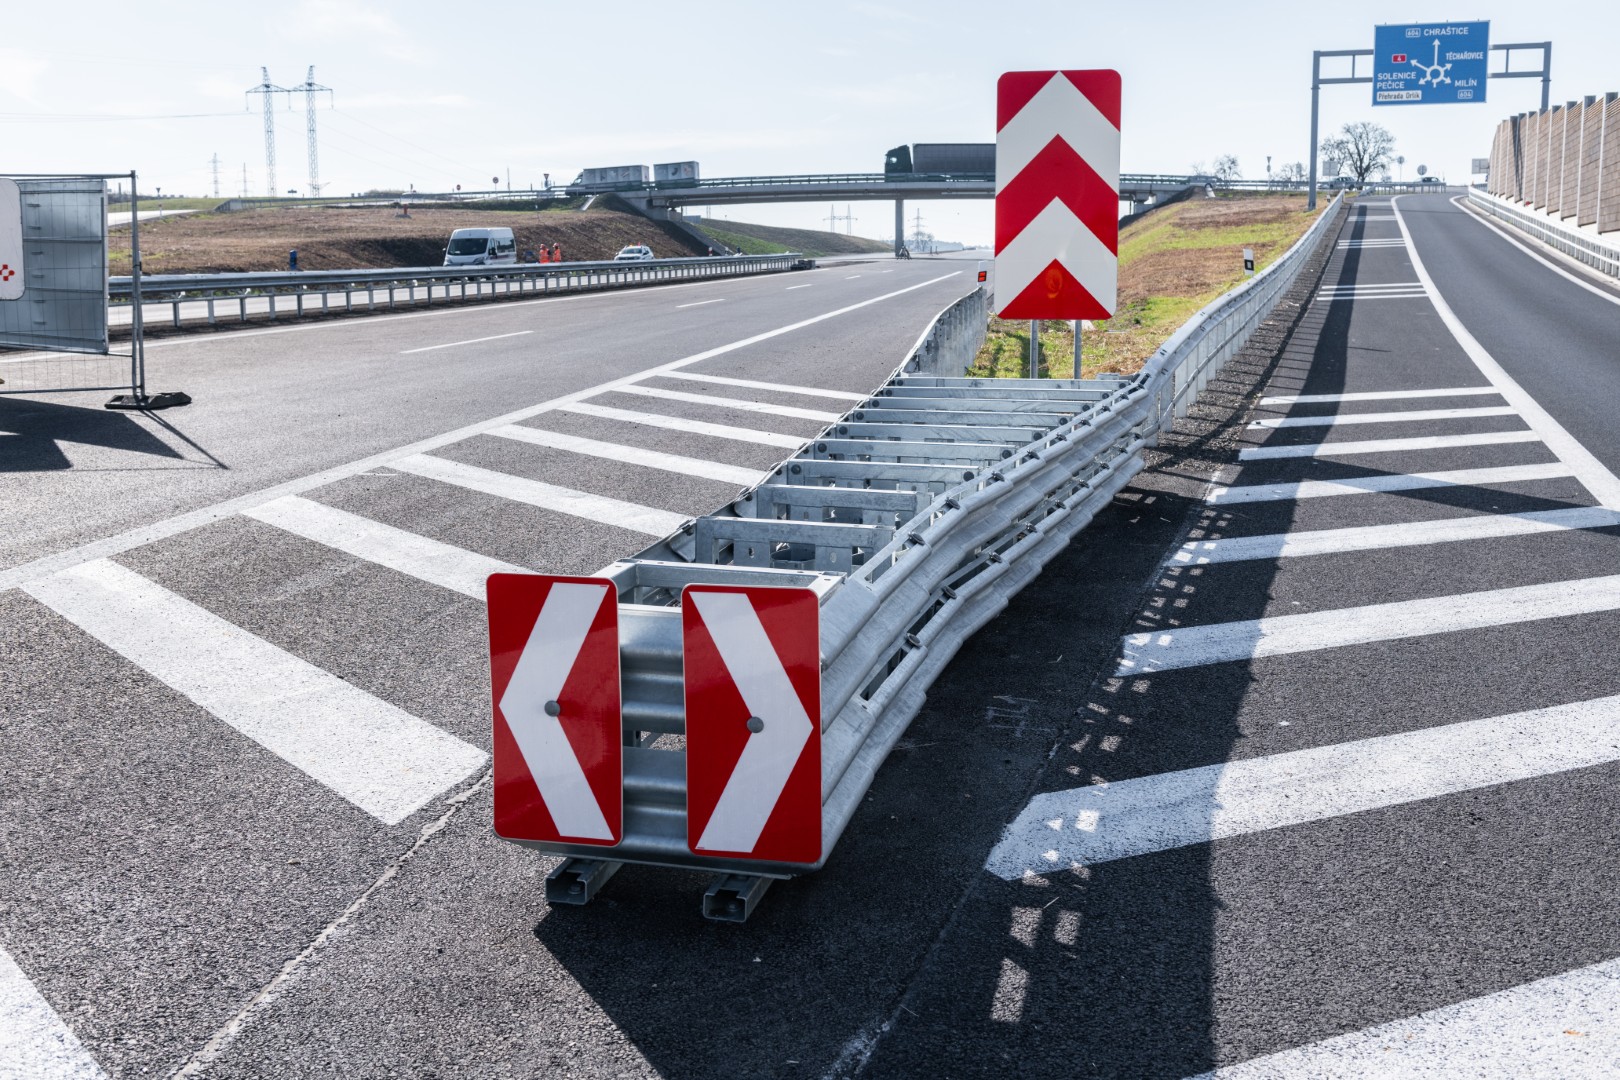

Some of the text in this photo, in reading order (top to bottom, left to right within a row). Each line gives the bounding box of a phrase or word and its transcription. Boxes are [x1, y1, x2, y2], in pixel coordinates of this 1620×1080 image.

[1424, 27, 1468, 36] CHRAŠTICE
[1378, 72, 1416, 80] SOLENICE
[1377, 81, 1405, 89] PEČICE
[1454, 78, 1477, 87] MILÍN
